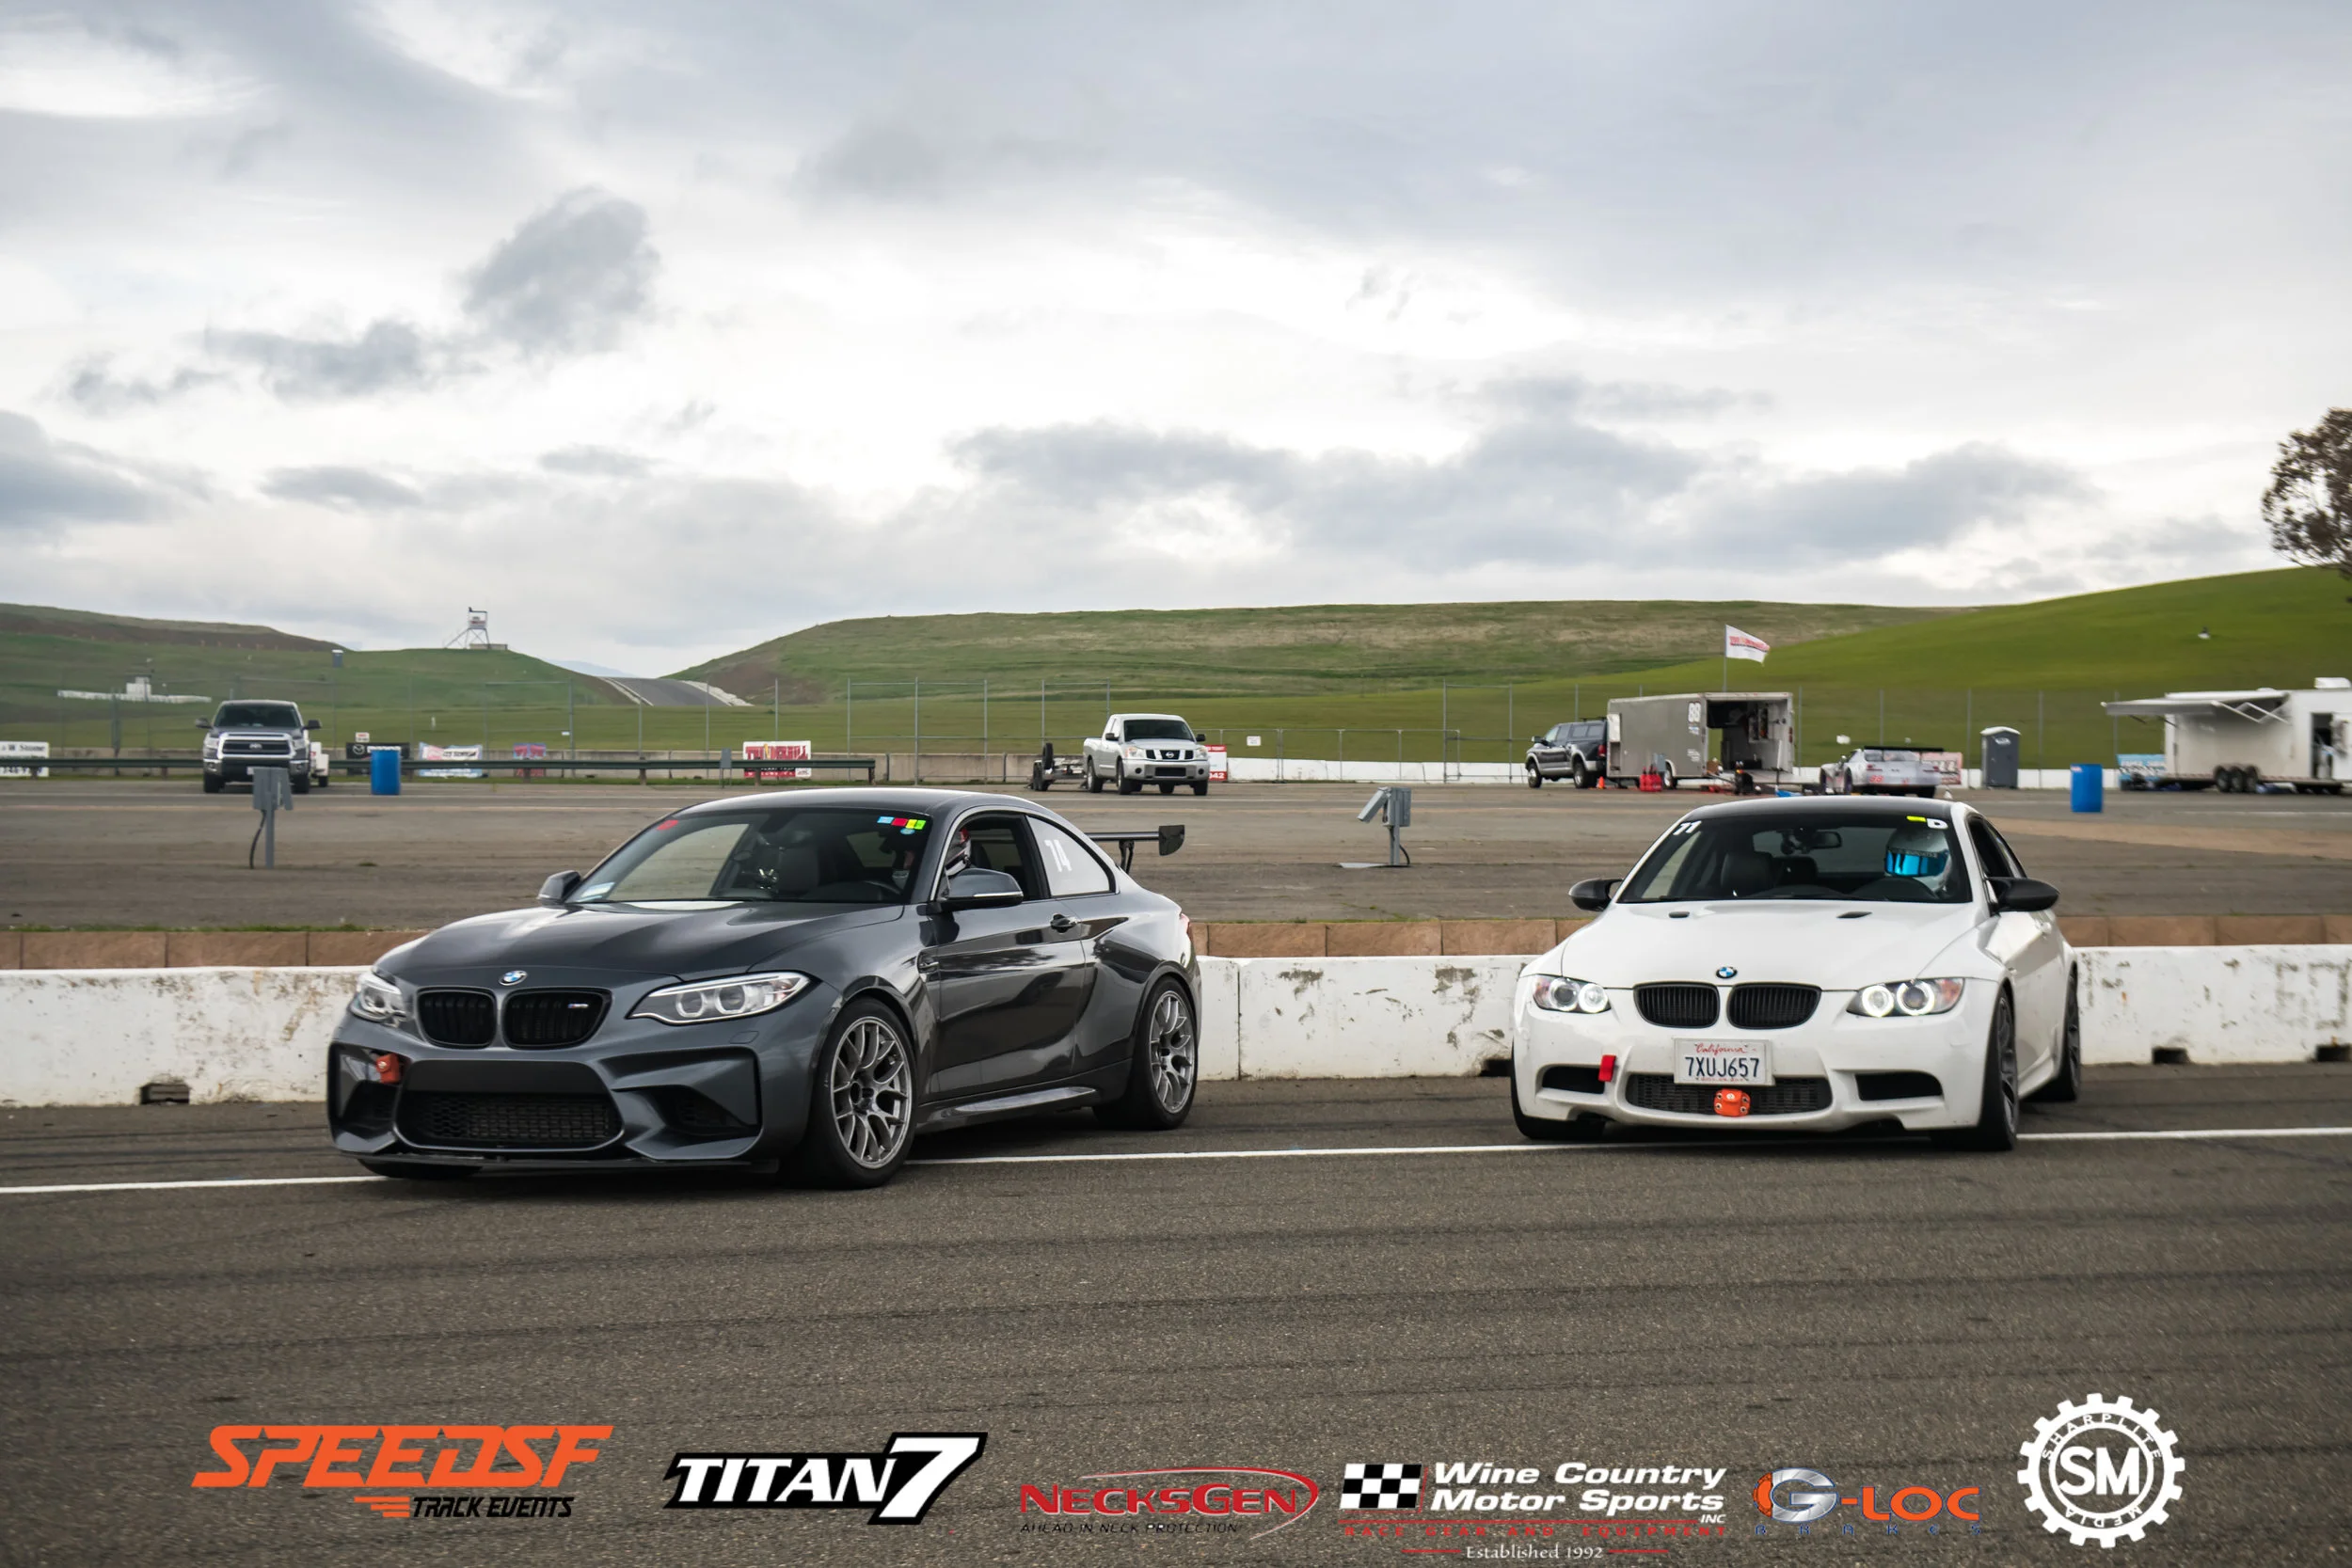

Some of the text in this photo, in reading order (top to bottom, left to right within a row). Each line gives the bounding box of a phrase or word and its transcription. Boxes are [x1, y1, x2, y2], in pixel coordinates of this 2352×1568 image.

[1688, 702, 1701, 722] 88
[1673, 820, 1702, 835] 11
[1927, 817, 1948, 830] D
[1695, 1043, 1748, 1055] California
[1685, 1056, 1759, 1078] 7XUJ657
